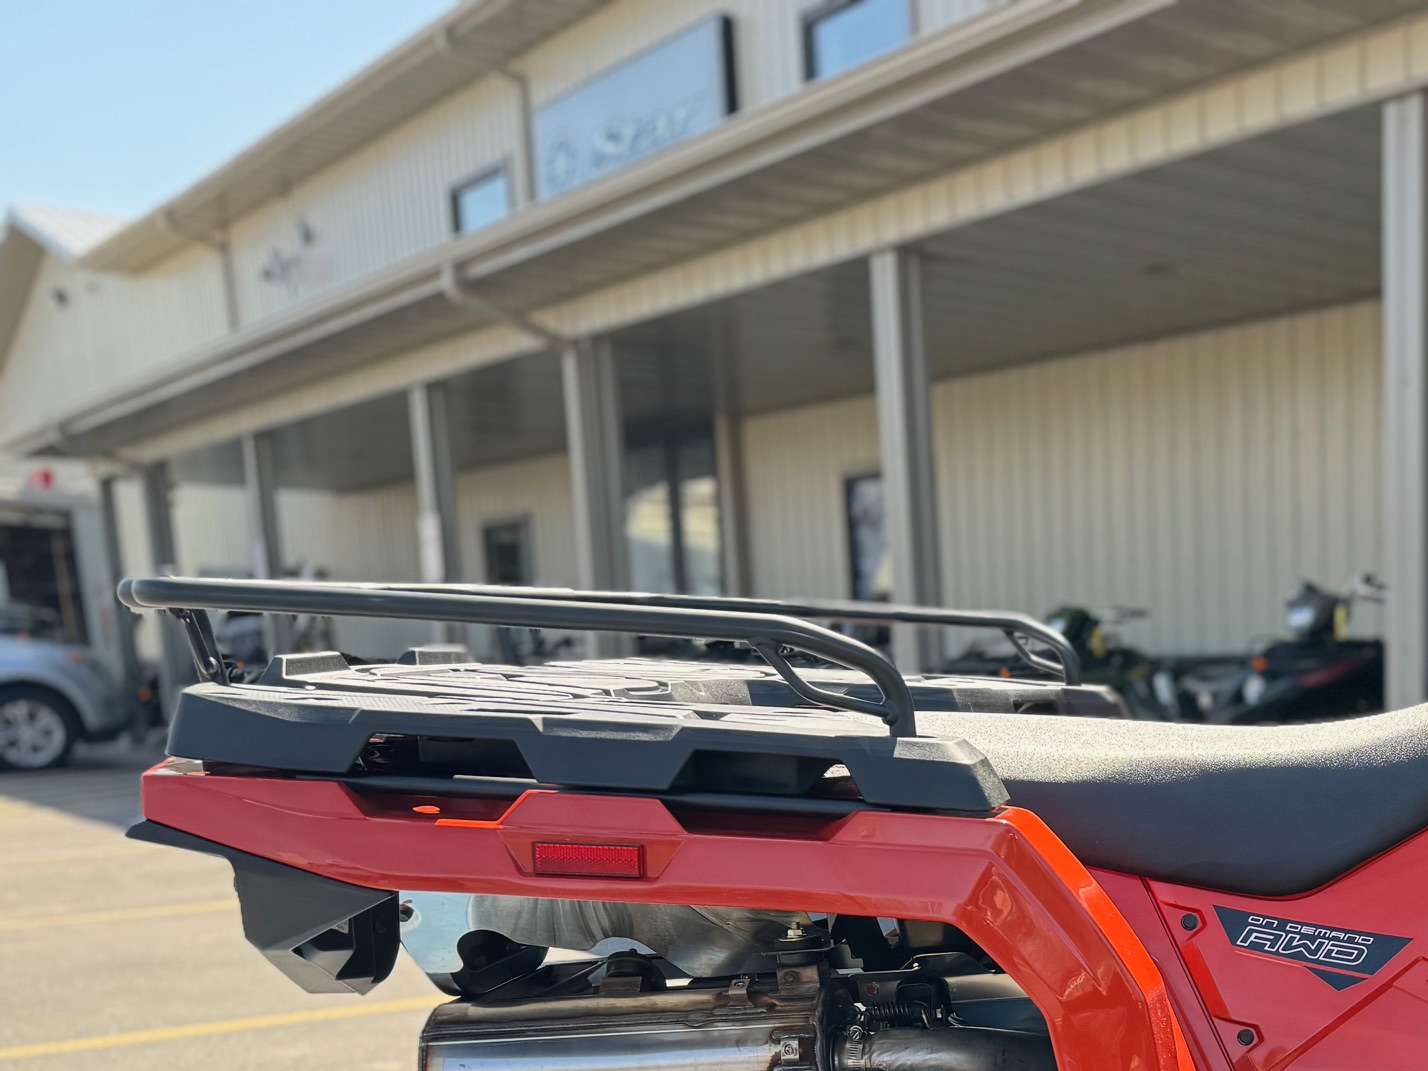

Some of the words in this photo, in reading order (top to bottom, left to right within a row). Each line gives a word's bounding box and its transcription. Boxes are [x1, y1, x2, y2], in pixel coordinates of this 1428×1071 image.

[1236, 926, 1368, 965] AWD
[1248, 915, 1278, 928] ON
[1286, 923, 1374, 944] DEMAND
